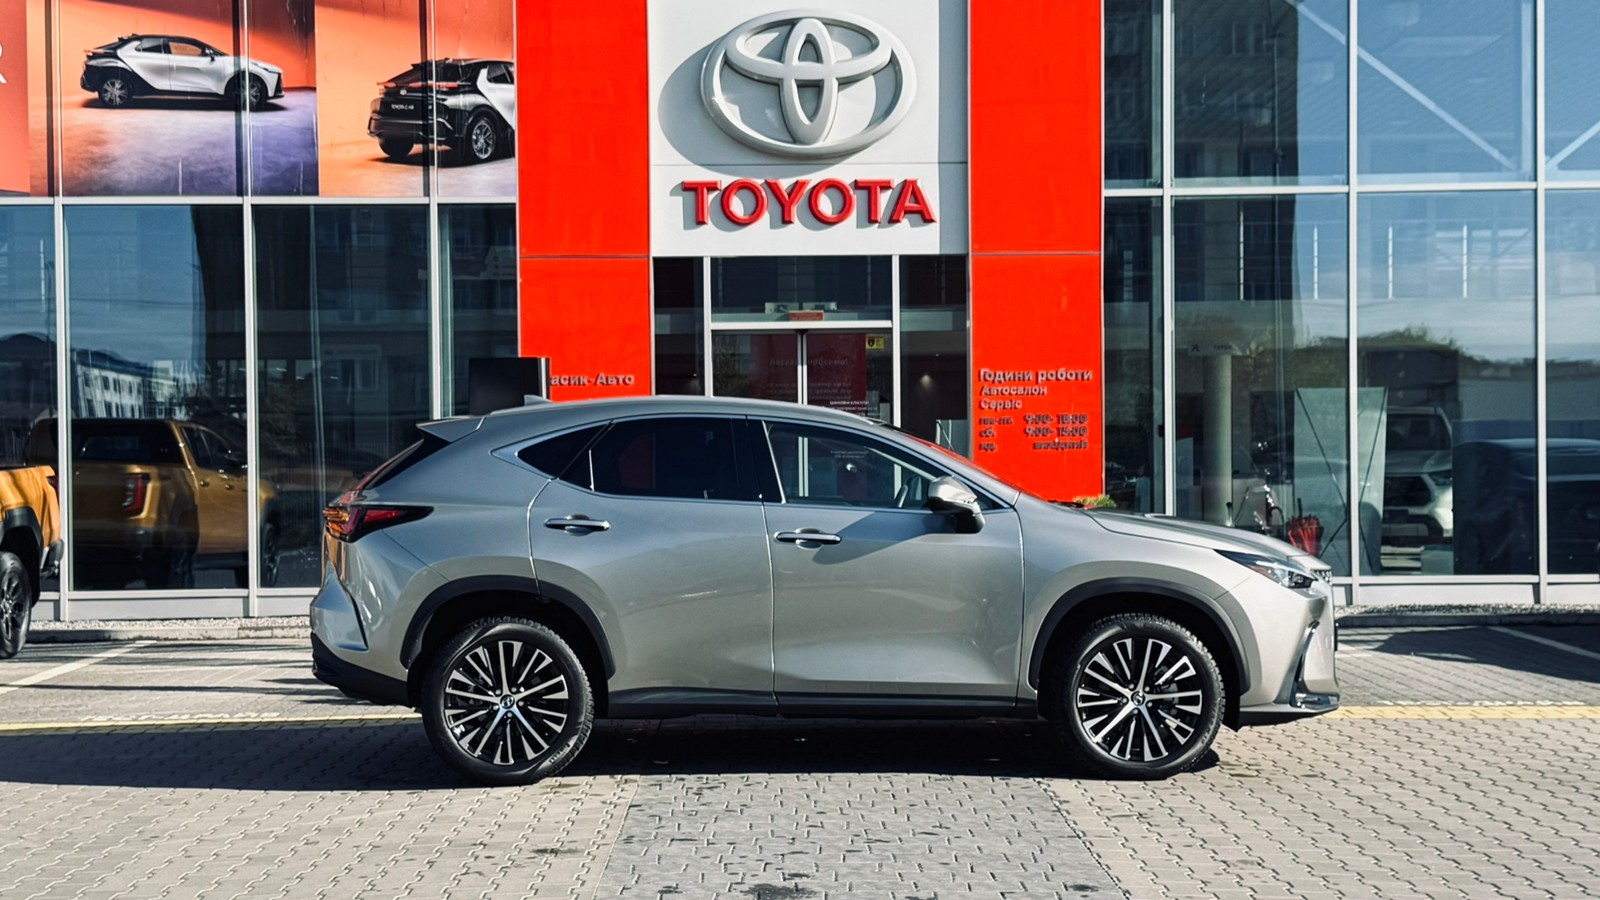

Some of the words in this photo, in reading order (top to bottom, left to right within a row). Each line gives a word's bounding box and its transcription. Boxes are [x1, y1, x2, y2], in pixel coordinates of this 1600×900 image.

[682, 178, 937, 225] TOYOTA
[979, 368, 1034, 383] Години
[1036, 367, 1093, 383] роботи
[980, 385, 1048, 396] Автосалон
[980, 399, 1023, 411] Сервіс
